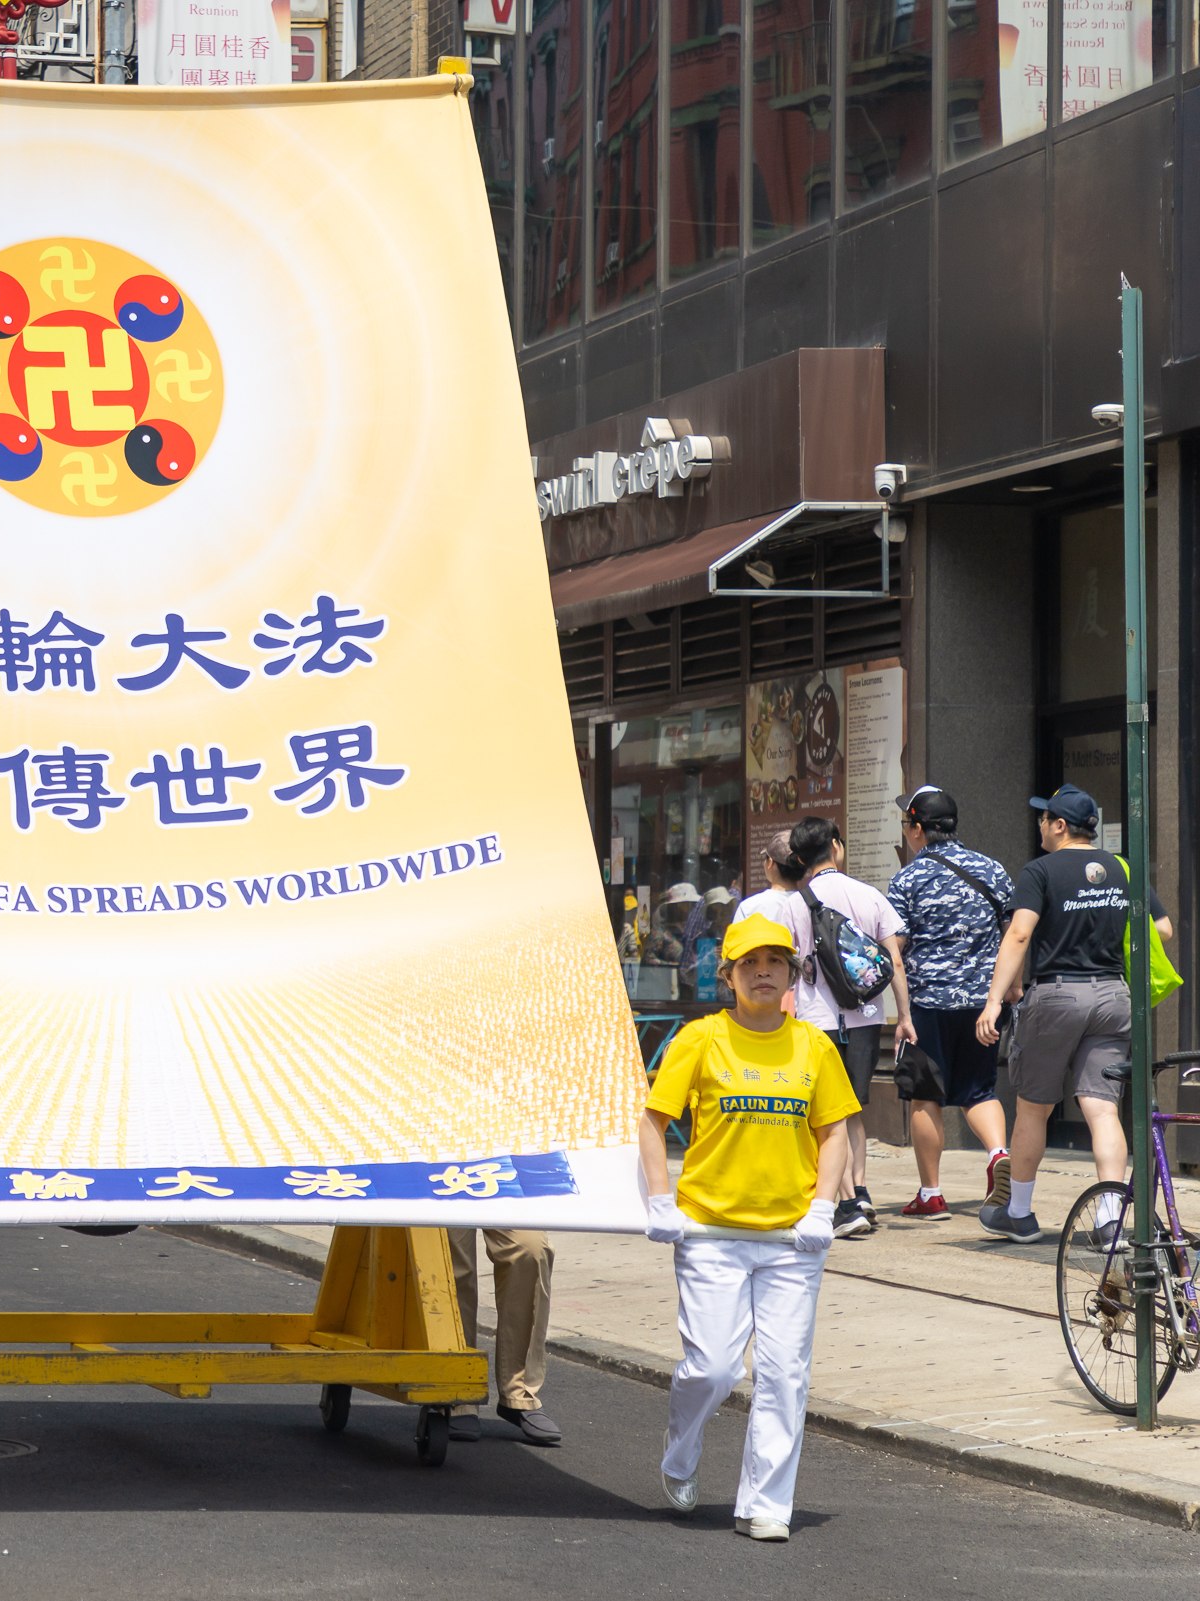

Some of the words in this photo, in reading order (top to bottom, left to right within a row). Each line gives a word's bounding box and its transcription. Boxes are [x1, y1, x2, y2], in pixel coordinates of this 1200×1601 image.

[189, 4, 239, 17] Reunion
[167, 33, 270, 60] 月圓桂香
[537, 451, 614, 521] swirl
[46, 881, 227, 914] SPREADS
[233, 834, 502, 906] WORLDWIDE
[1106, 887, 1114, 896] of
[1113, 887, 1124, 895] the
[715, 1068, 812, 1088] 法輪大法
[722, 1098, 769, 1111] FALUN
[773, 1099, 806, 1115] DAFA
